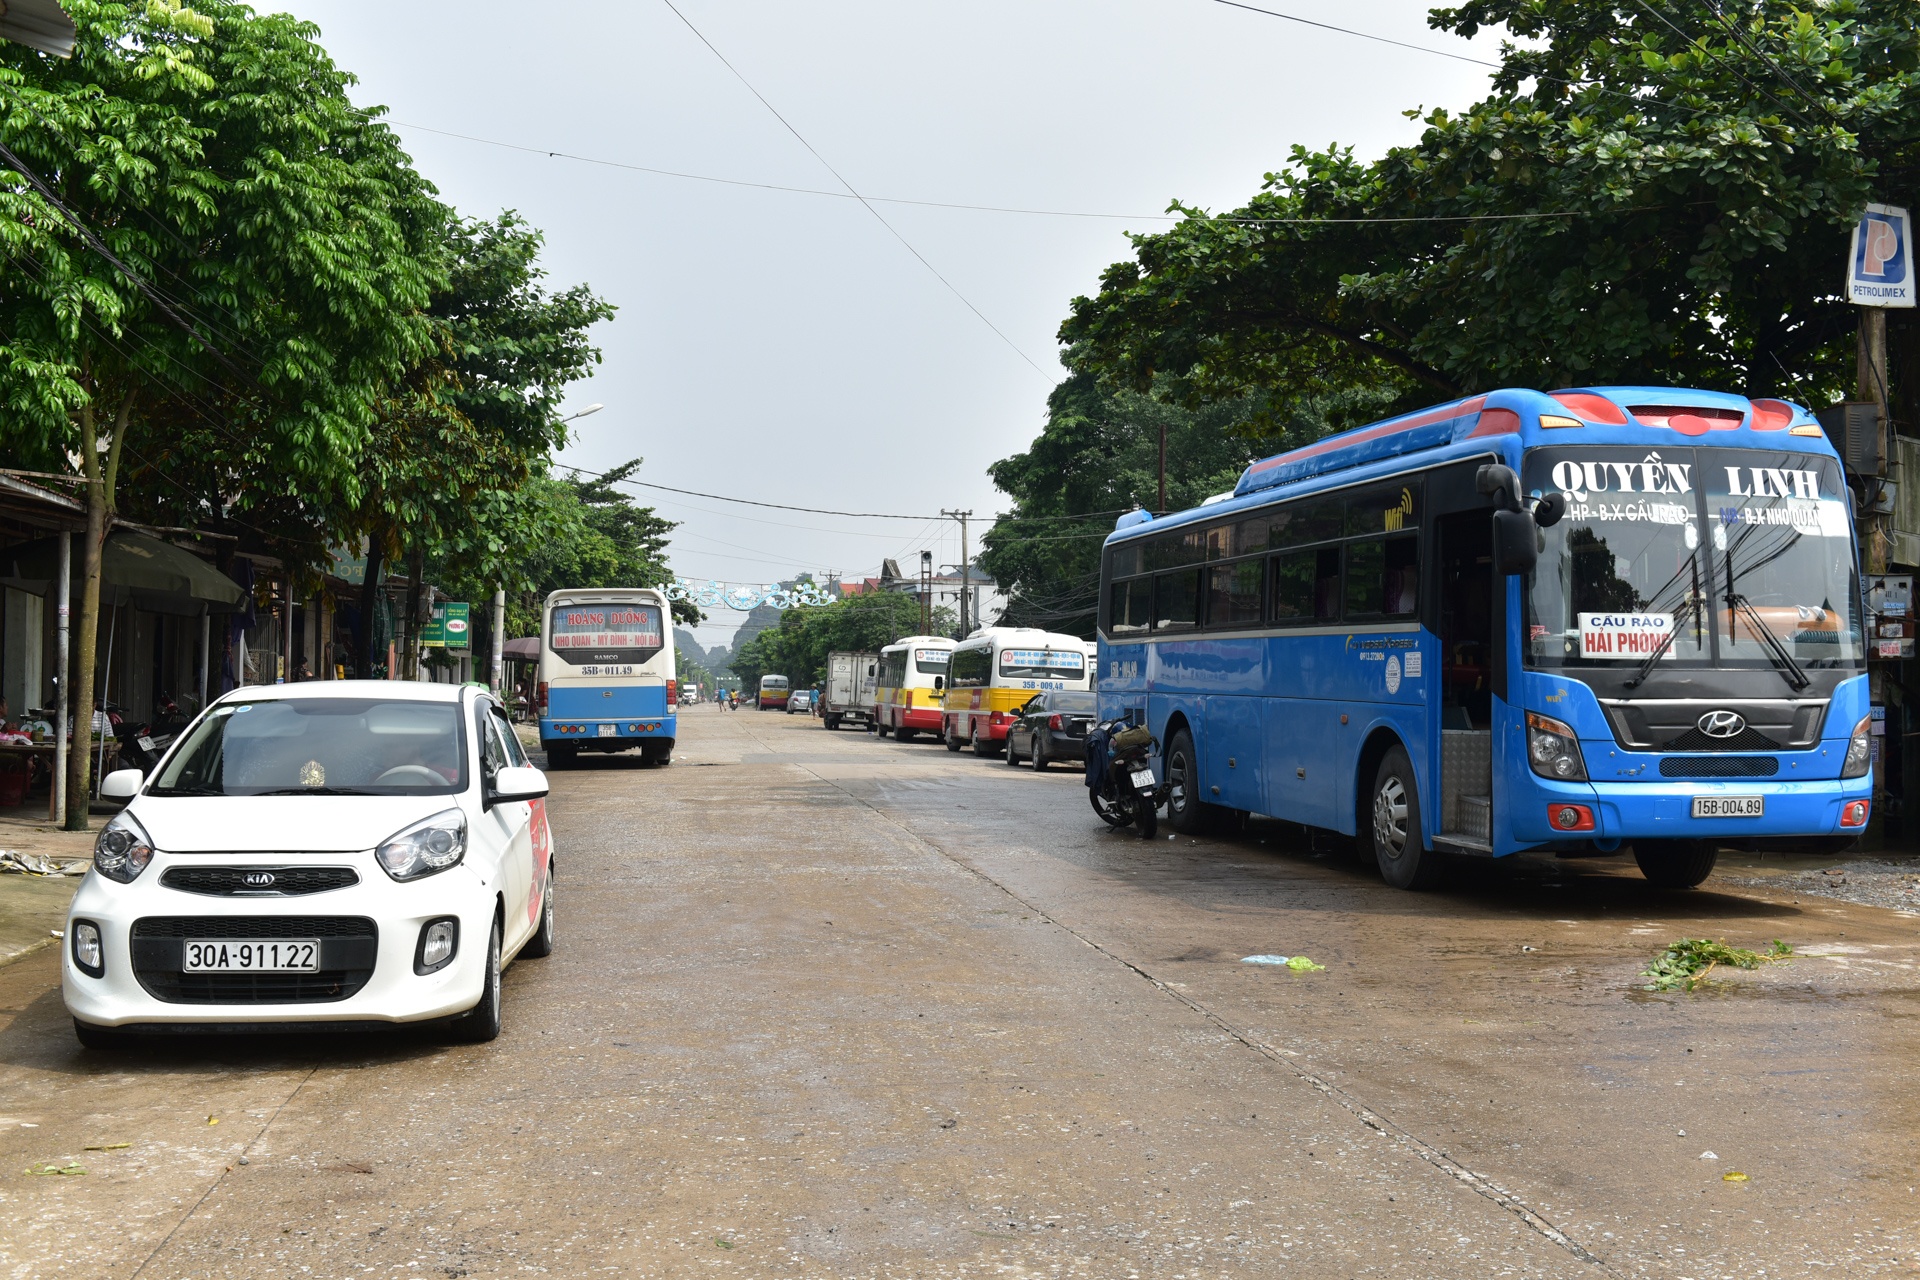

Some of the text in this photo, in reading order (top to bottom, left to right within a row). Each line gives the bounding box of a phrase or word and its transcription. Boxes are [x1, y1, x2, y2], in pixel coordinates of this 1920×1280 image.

[1854, 285, 1905, 298] PETROLIMEX
[1552, 451, 1821, 501] QUYỀN LINH
[1570, 504, 1589, 521] HP
[1720, 507, 1739, 524] NB
[1766, 508, 1790, 525] NHO
[1631, 616, 1664, 627] RÀO
[555, 635, 570, 647] NHO
[571, 635, 591, 647] QUAN
[1585, 627, 1671, 653] HẢI PHÒNG
[582, 666, 598, 675] 35B
[604, 666, 632, 675] 011.49
[1696, 800, 1761, 815] 15B-004.89
[247, 874, 269, 884] KIA
[189, 944, 314, 968] 30A-911.22
